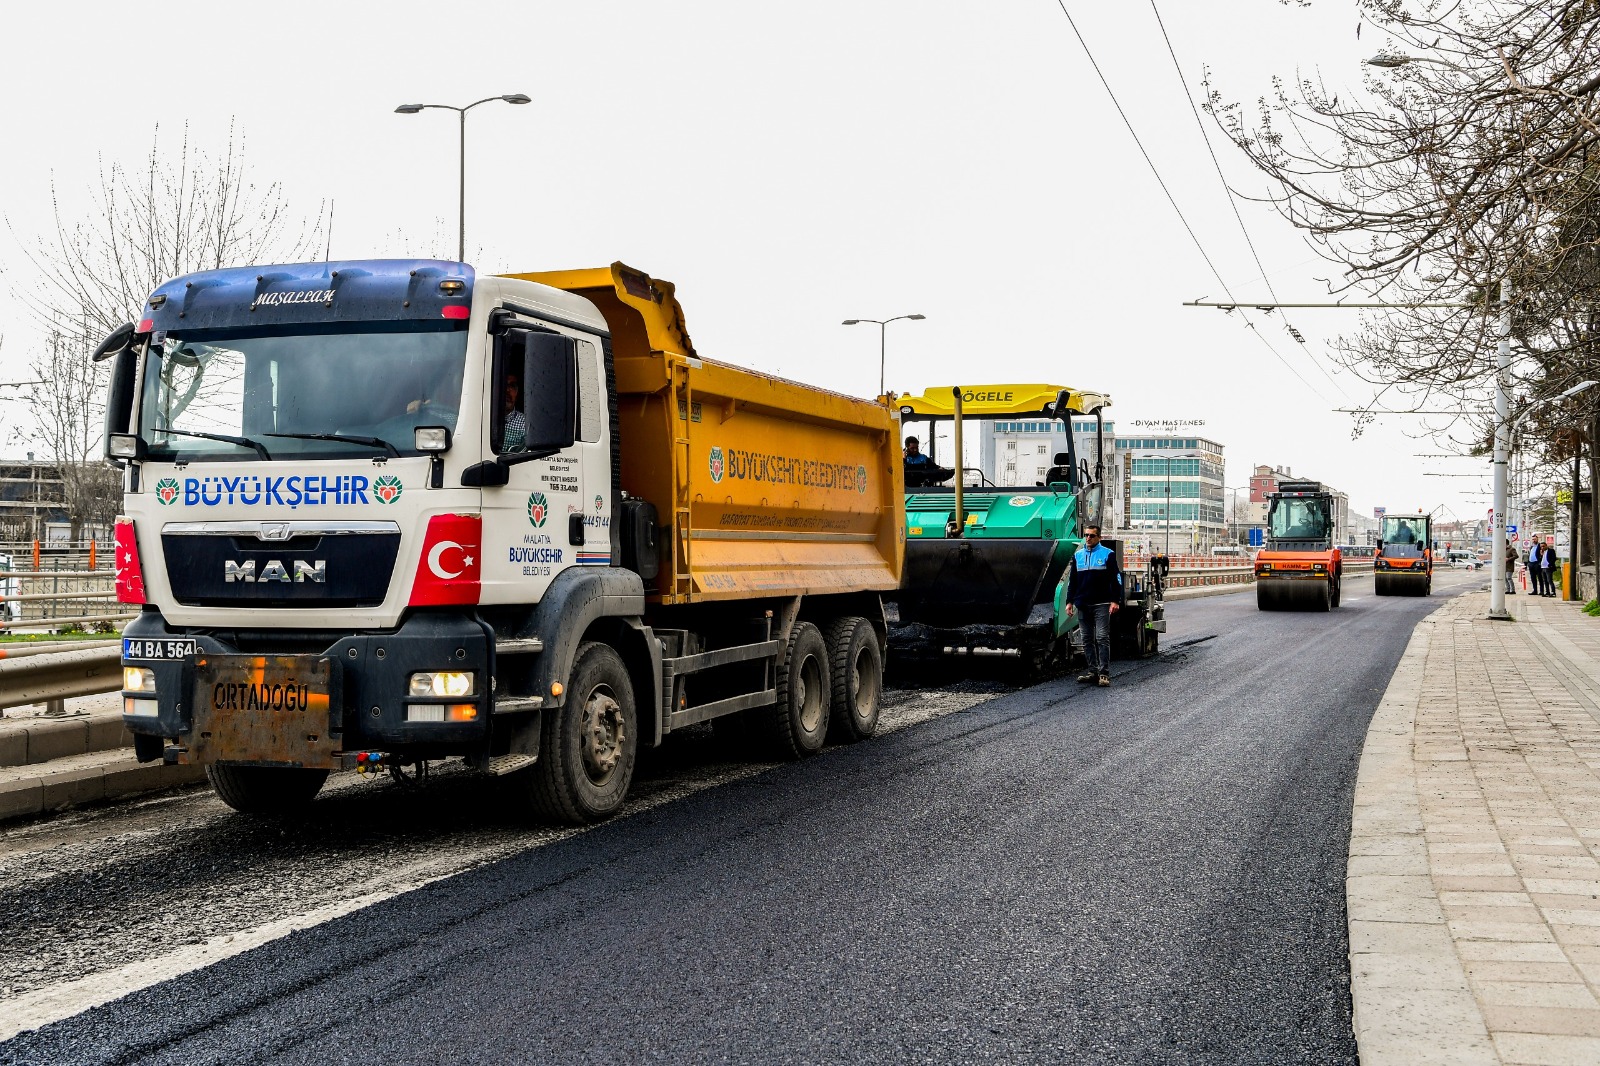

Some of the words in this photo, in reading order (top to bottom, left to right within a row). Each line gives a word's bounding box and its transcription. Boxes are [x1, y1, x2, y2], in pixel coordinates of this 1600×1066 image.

[252, 289, 336, 306] MAŞALLAH
[961, 390, 1013, 403] ÖGELE
[184, 475, 370, 509] BÜYÜKŞEHİR
[524, 534, 551, 545] MALATYA
[509, 546, 563, 565] BÜYÜKŞEHİR
[225, 560, 326, 583] MAN
[523, 566, 551, 576] BELEDİYESİ
[128, 641, 142, 657] 44
[145, 641, 163, 658] BA
[167, 642, 193, 658] 564
[214, 677, 308, 711] ORTADOĞU
